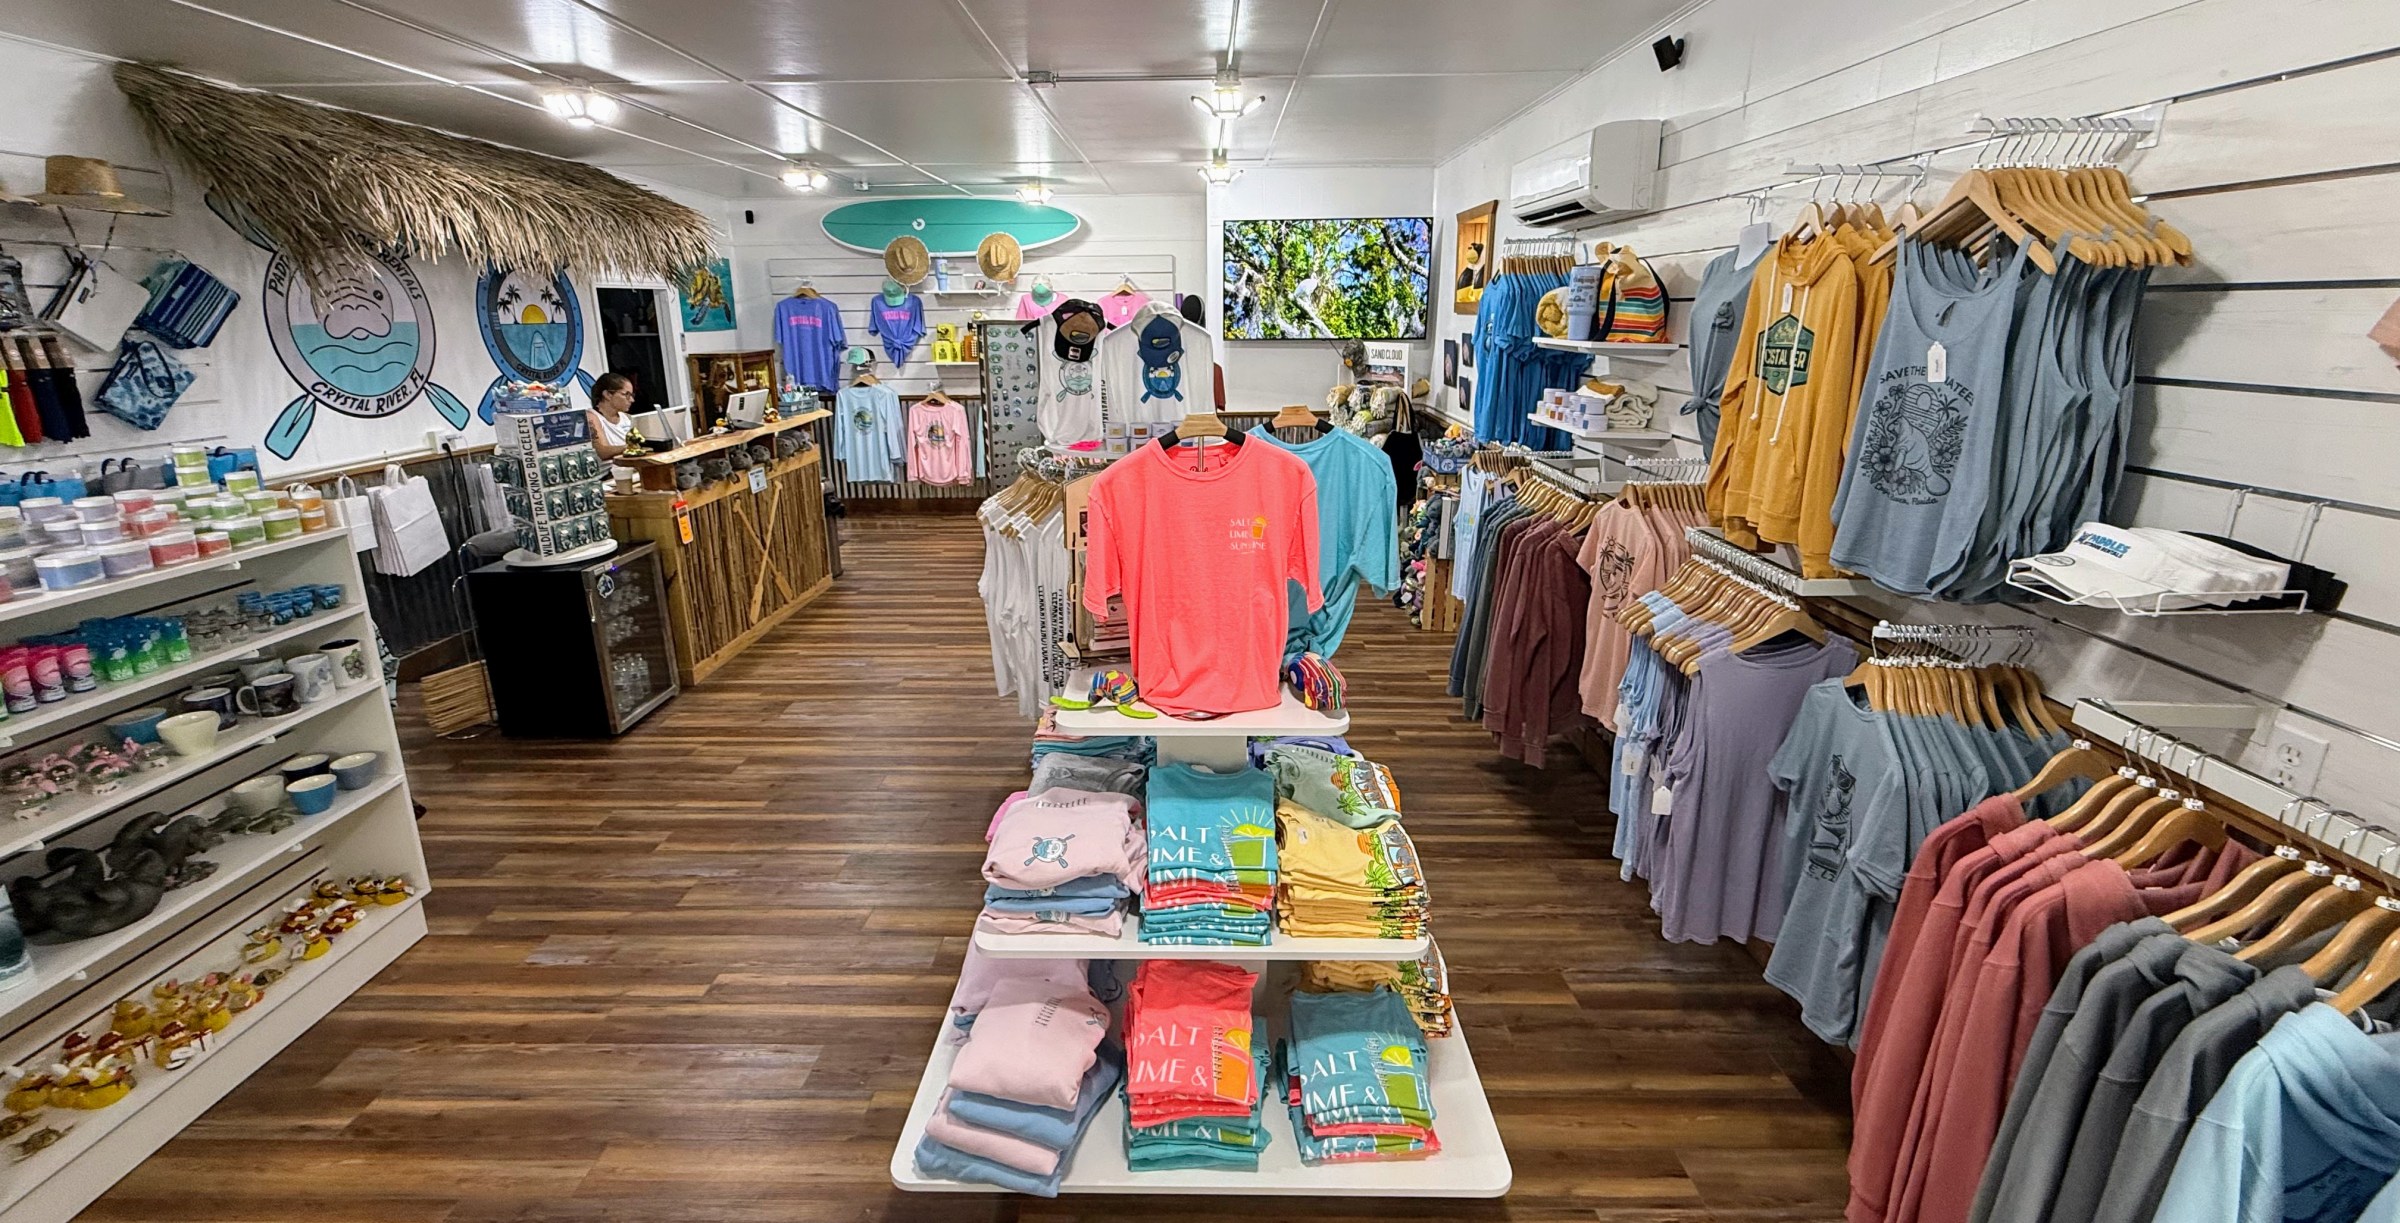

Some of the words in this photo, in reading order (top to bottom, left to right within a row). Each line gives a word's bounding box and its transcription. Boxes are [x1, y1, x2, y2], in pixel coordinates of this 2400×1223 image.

[378, 250, 423, 300] RENTALS
[1371, 349, 1385, 360] SAND
[1386, 350, 1403, 361] CLOUD
[310, 381, 370, 412] CRYSTAL
[409, 367, 425, 389] FL
[1880, 366, 1909, 384] SAVE
[1910, 366, 1927, 377] THE
[517, 418, 537, 468] BRACELETS
[527, 471, 546, 518] TRACKING
[537, 520, 555, 558] WILDLIFE
[1149, 846, 1203, 863] IME
[1209, 852, 1224, 866] &
[1130, 1058, 1186, 1084] IME
[1191, 1065, 1208, 1088] &
[1305, 1083, 1356, 1116] IME
[1363, 1085, 1380, 1106] &
